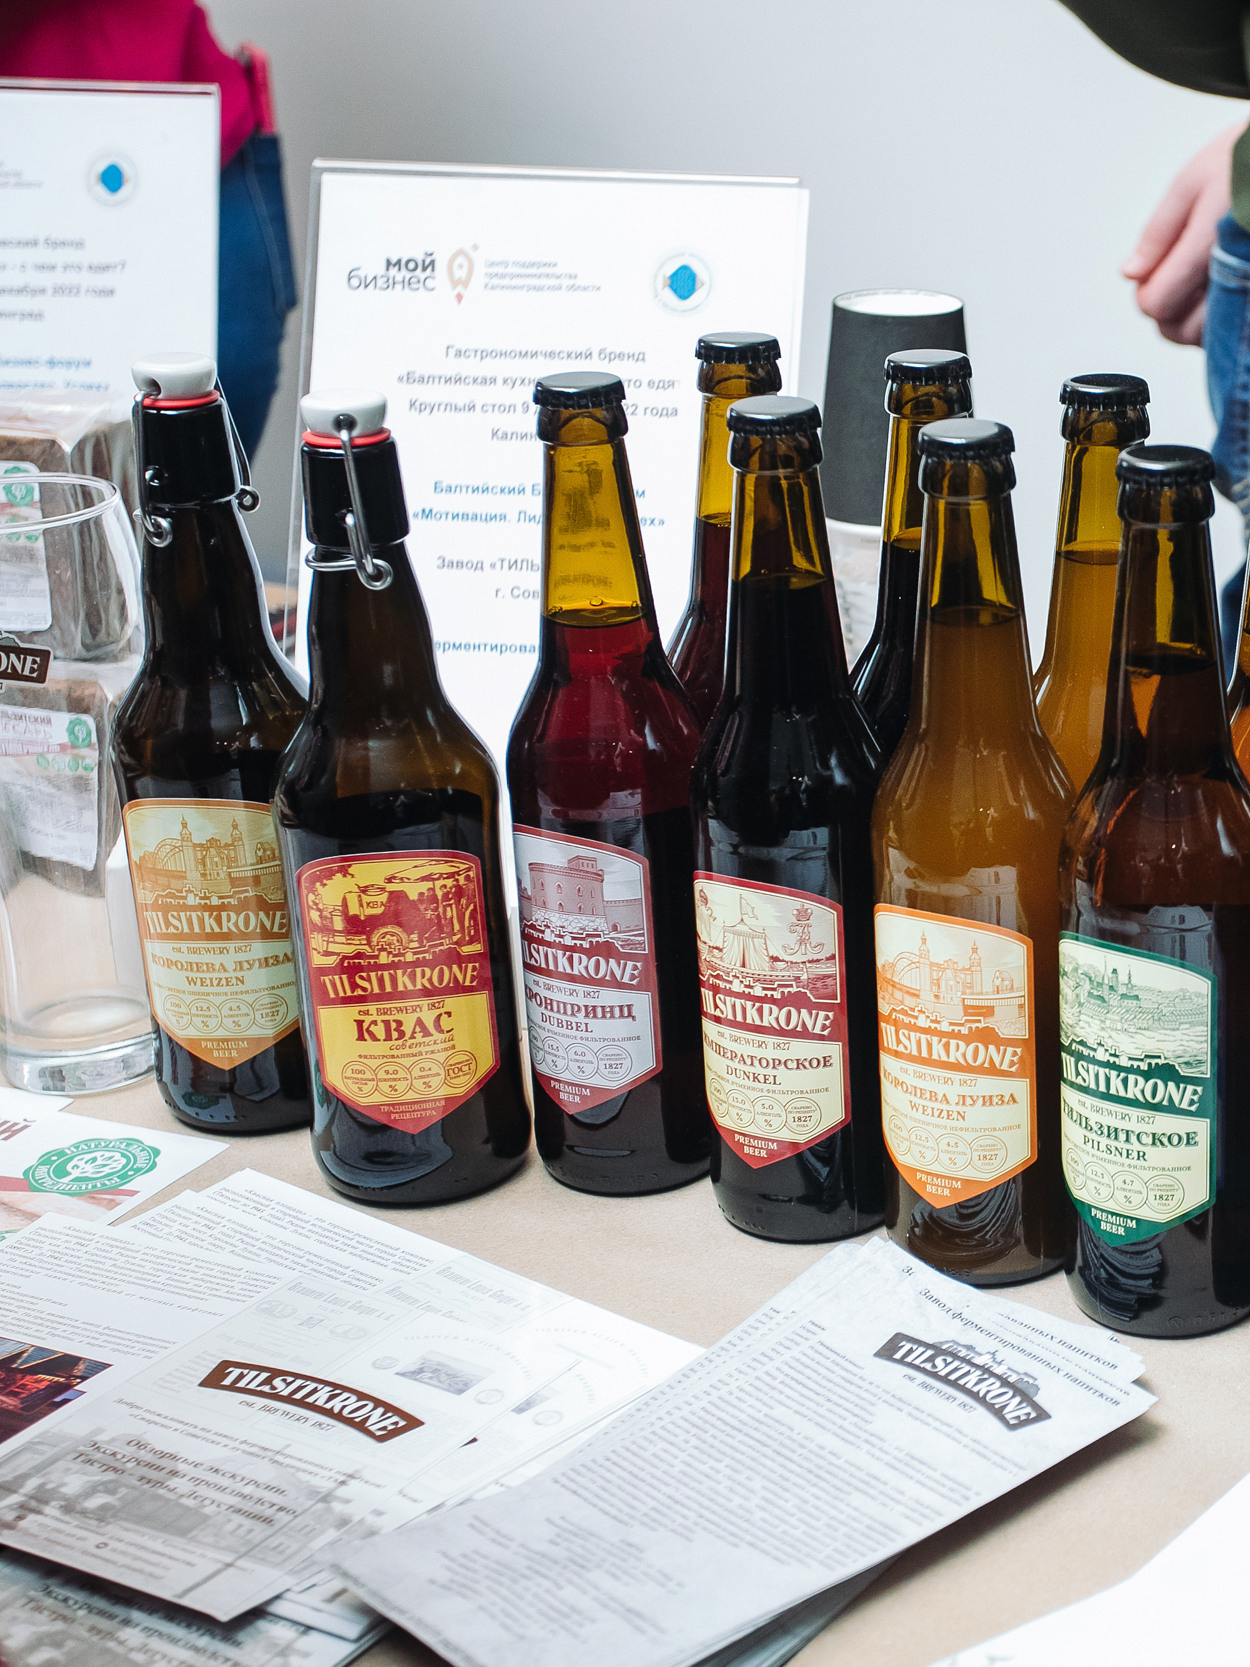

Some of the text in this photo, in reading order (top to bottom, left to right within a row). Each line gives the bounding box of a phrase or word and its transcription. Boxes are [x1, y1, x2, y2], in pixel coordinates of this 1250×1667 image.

[385, 251, 436, 272] мой
[348, 267, 436, 291] бизнес
[445, 345, 646, 364] Гастрономический бренд
[409, 399, 476, 414] Круглый
[481, 403, 517, 414] стол
[644, 406, 678, 418] года
[433, 481, 525, 495] Балтийский
[437, 556, 540, 572] Завод «ТИЛЬ
[433, 640, 539, 654] ерментирова
[0, 652, 40, 677] ONE
[144, 910, 287, 934] TILSITKRONE
[187, 946, 231, 955] BREWERY
[234, 944, 252, 954] 1827
[151, 952, 292, 973] КОРОЛЕВА ЛУИЗА
[185, 976, 245, 987] WEIZEN
[320, 963, 480, 999] TILSITKRONE
[543, 981, 600, 999] BREWERY 1827
[376, 1004, 424, 1016] BREWERY
[427, 1000, 446, 1012] 1827
[353, 1011, 454, 1042] КВАС
[540, 1012, 593, 1033] DUBBEL
[201, 1041, 248, 1049] PREMIUM
[389, 1034, 455, 1051] советский
[729, 1033, 791, 1051] BREWERY 1827
[880, 1022, 1023, 1073] TILSITKRONE
[725, 1064, 782, 1086] DUNKEL
[913, 1071, 978, 1088] BREWERY 1827
[550, 1080, 590, 1096] PREMIUM
[882, 1066, 1019, 1107] КОРОЛЕВА ЛУИЗА
[380, 1100, 446, 1112] ТРАДИЦИОННАЯ
[559, 1092, 581, 1103] BEER
[390, 1110, 437, 1120] РЕЦЕПТУРА
[792, 1115, 812, 1123] 1827
[908, 1100, 966, 1122] WEIZEN
[1090, 1104, 1156, 1126] BREWERY 1827
[1062, 1096, 1199, 1148] ТИЛЬЗИТСКОЕ
[734, 1134, 777, 1150] PREMIUM
[744, 1145, 767, 1158] BEER
[1083, 1134, 1147, 1162] PILSNER
[977, 1153, 998, 1162] 1827
[916, 1172, 962, 1188] PREMIUM
[926, 1184, 951, 1196] BEER
[1091, 1208, 1137, 1229] PREMIUM
[1100, 1222, 1126, 1236] BEER
[919, 1287, 952, 1316] Завод
[1063, 1372, 1121, 1407] напитков
[892, 1341, 1037, 1425] TILSITKRONE
[917, 1380, 958, 1404] BREWERY
[220, 1366, 407, 1437] TILSITKRONE
[258, 1404, 311, 1424] BREWERY
[72, 1452, 125, 1475] Гастро
[84, 1441, 164, 1473] Экскурсии
[126, 1439, 204, 1469] Обзорные
